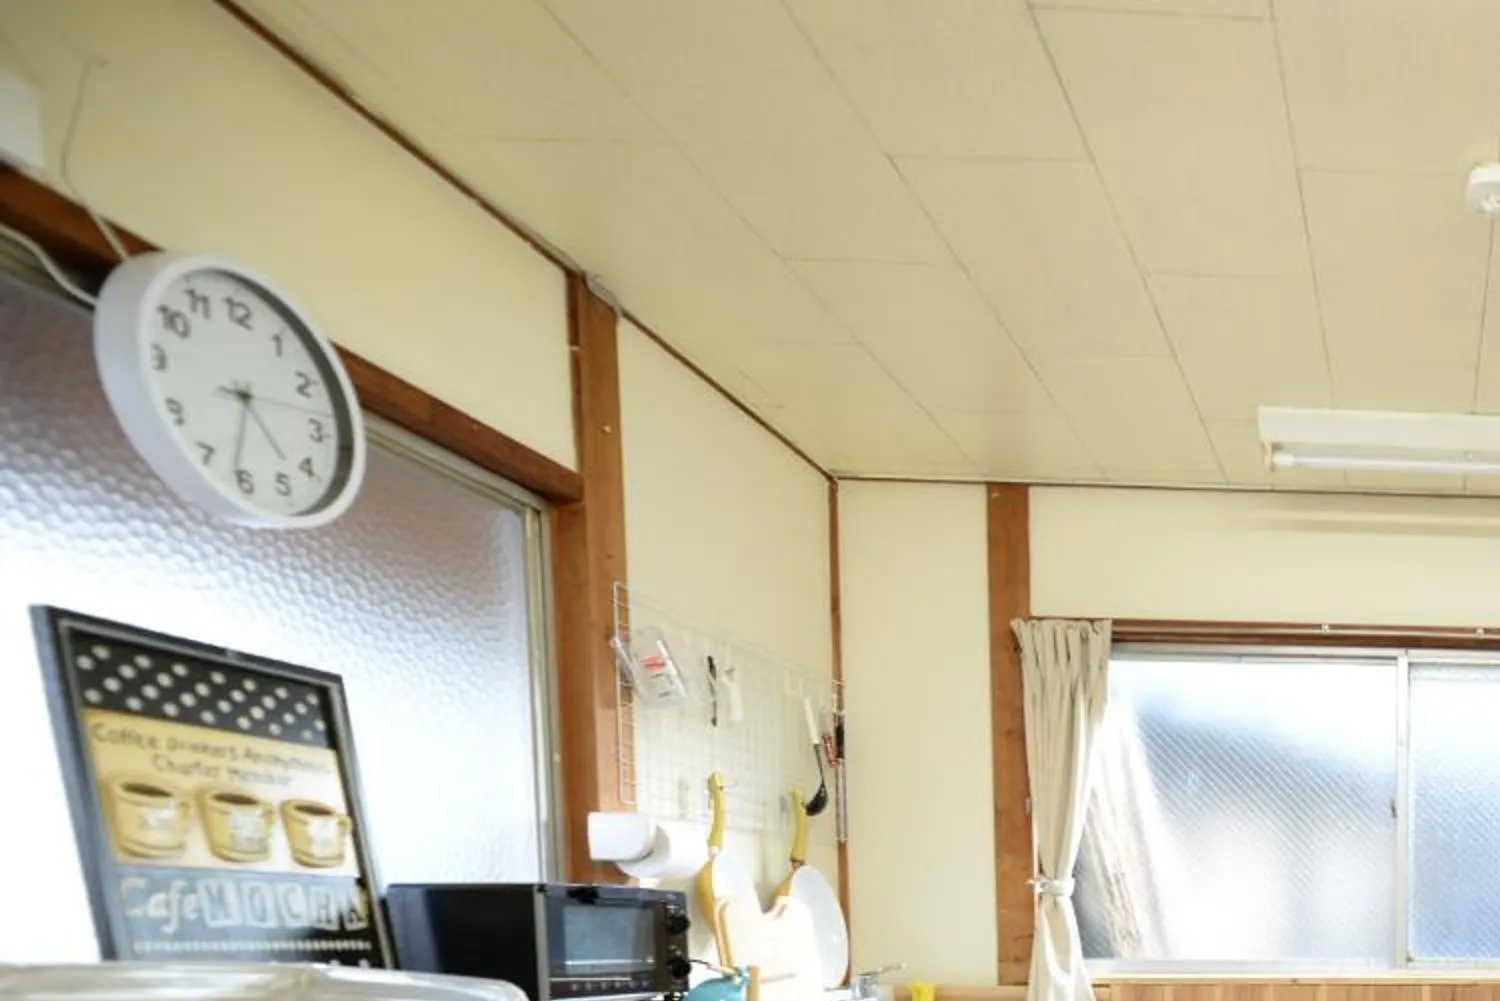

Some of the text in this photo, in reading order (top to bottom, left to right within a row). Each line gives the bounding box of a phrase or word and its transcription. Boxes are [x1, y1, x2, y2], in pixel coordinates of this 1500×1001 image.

[184, 289, 210, 319] 11
[222, 297, 253, 331] 12
[157, 304, 191, 339] 10
[272, 334, 283, 356] 1
[295, 371, 318, 398] 2
[308, 419, 326, 443] 3
[196, 441, 216, 465] 7
[298, 457, 317, 480] 4
[236, 469, 255, 495] 6
[275, 473, 292, 497] 5
[91, 722, 160, 750] Coffee
